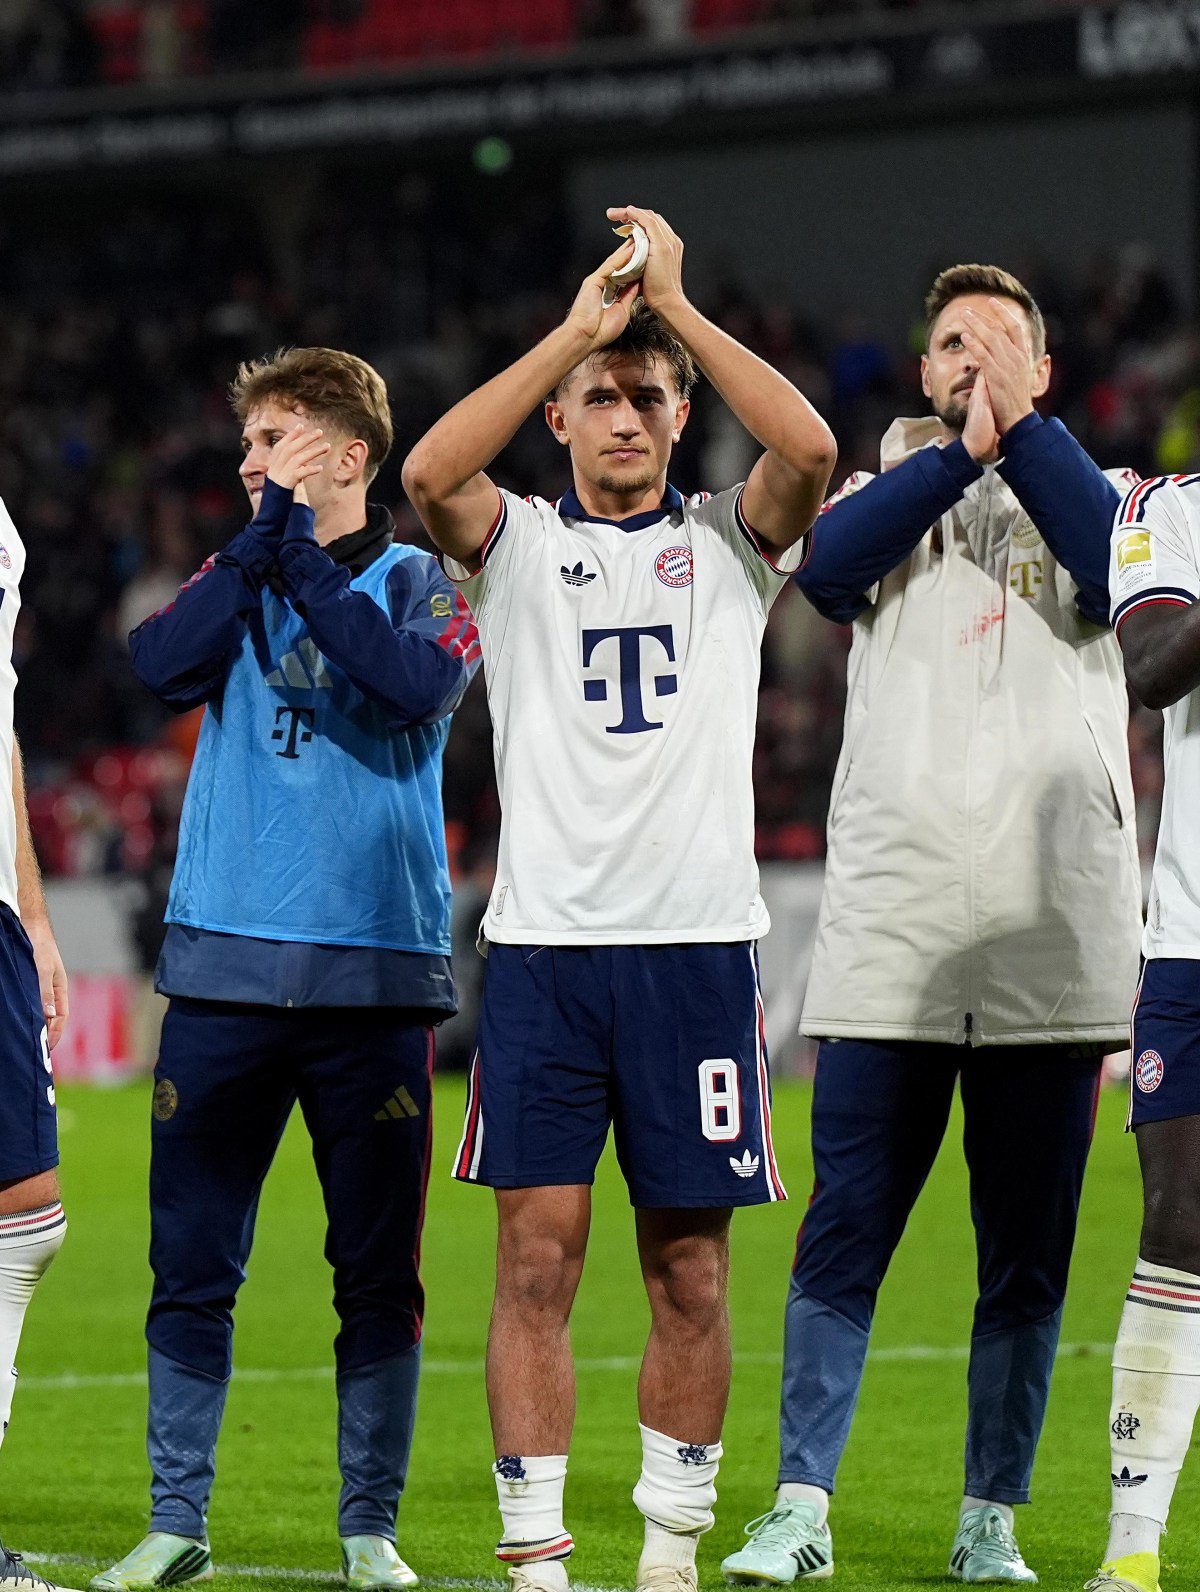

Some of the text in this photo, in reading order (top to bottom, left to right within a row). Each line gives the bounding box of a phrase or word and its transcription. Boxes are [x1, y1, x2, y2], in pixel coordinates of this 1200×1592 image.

[1010, 561, 1042, 598] T
[581, 624, 678, 734] T
[271, 706, 316, 759] T
[698, 1058, 742, 1142] 8
